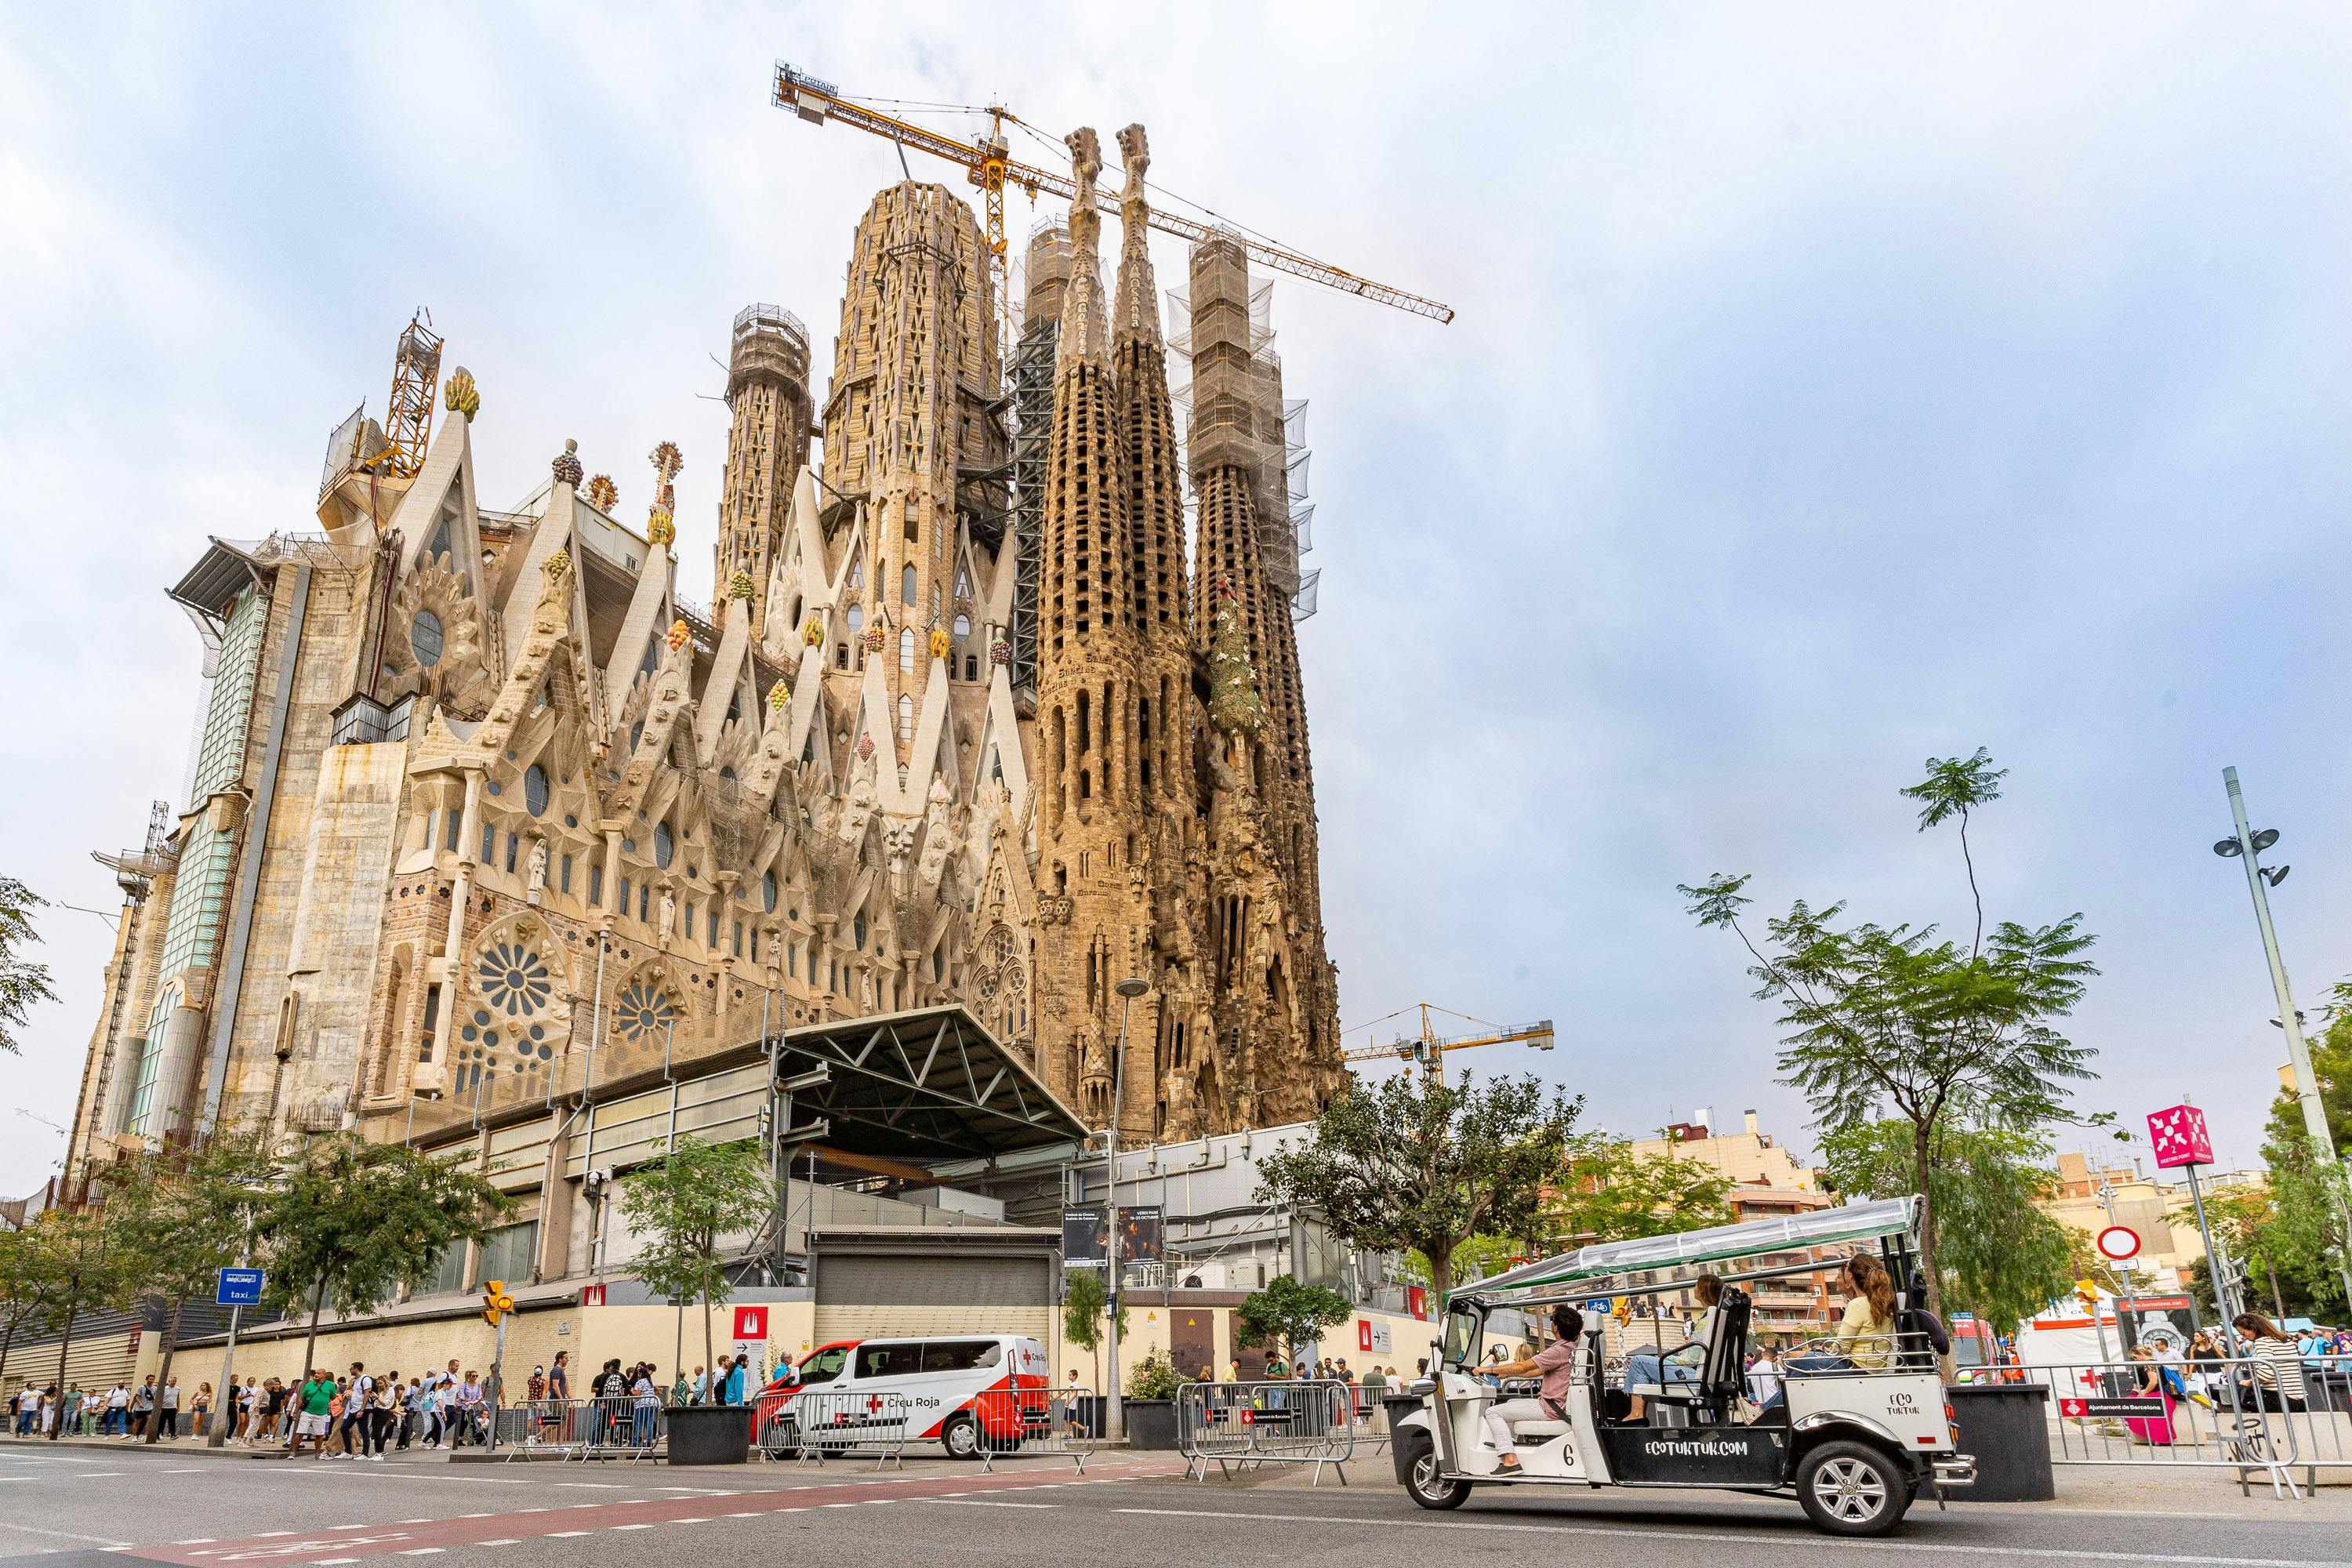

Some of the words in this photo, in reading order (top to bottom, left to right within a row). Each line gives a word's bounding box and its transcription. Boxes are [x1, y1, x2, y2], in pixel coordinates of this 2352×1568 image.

[804, 76, 836, 92] POTAIN
[2171, 1145, 2176, 1154] 2
[2199, 1143, 2204, 1152] 2
[230, 1290, 249, 1299] taxi
[887, 1398, 913, 1408] Creu
[916, 1396, 940, 1409] Roja
[1889, 1392, 1912, 1406] ECO
[1886, 1406, 1920, 1415] TUKTUK
[1563, 1443, 1574, 1466] 6
